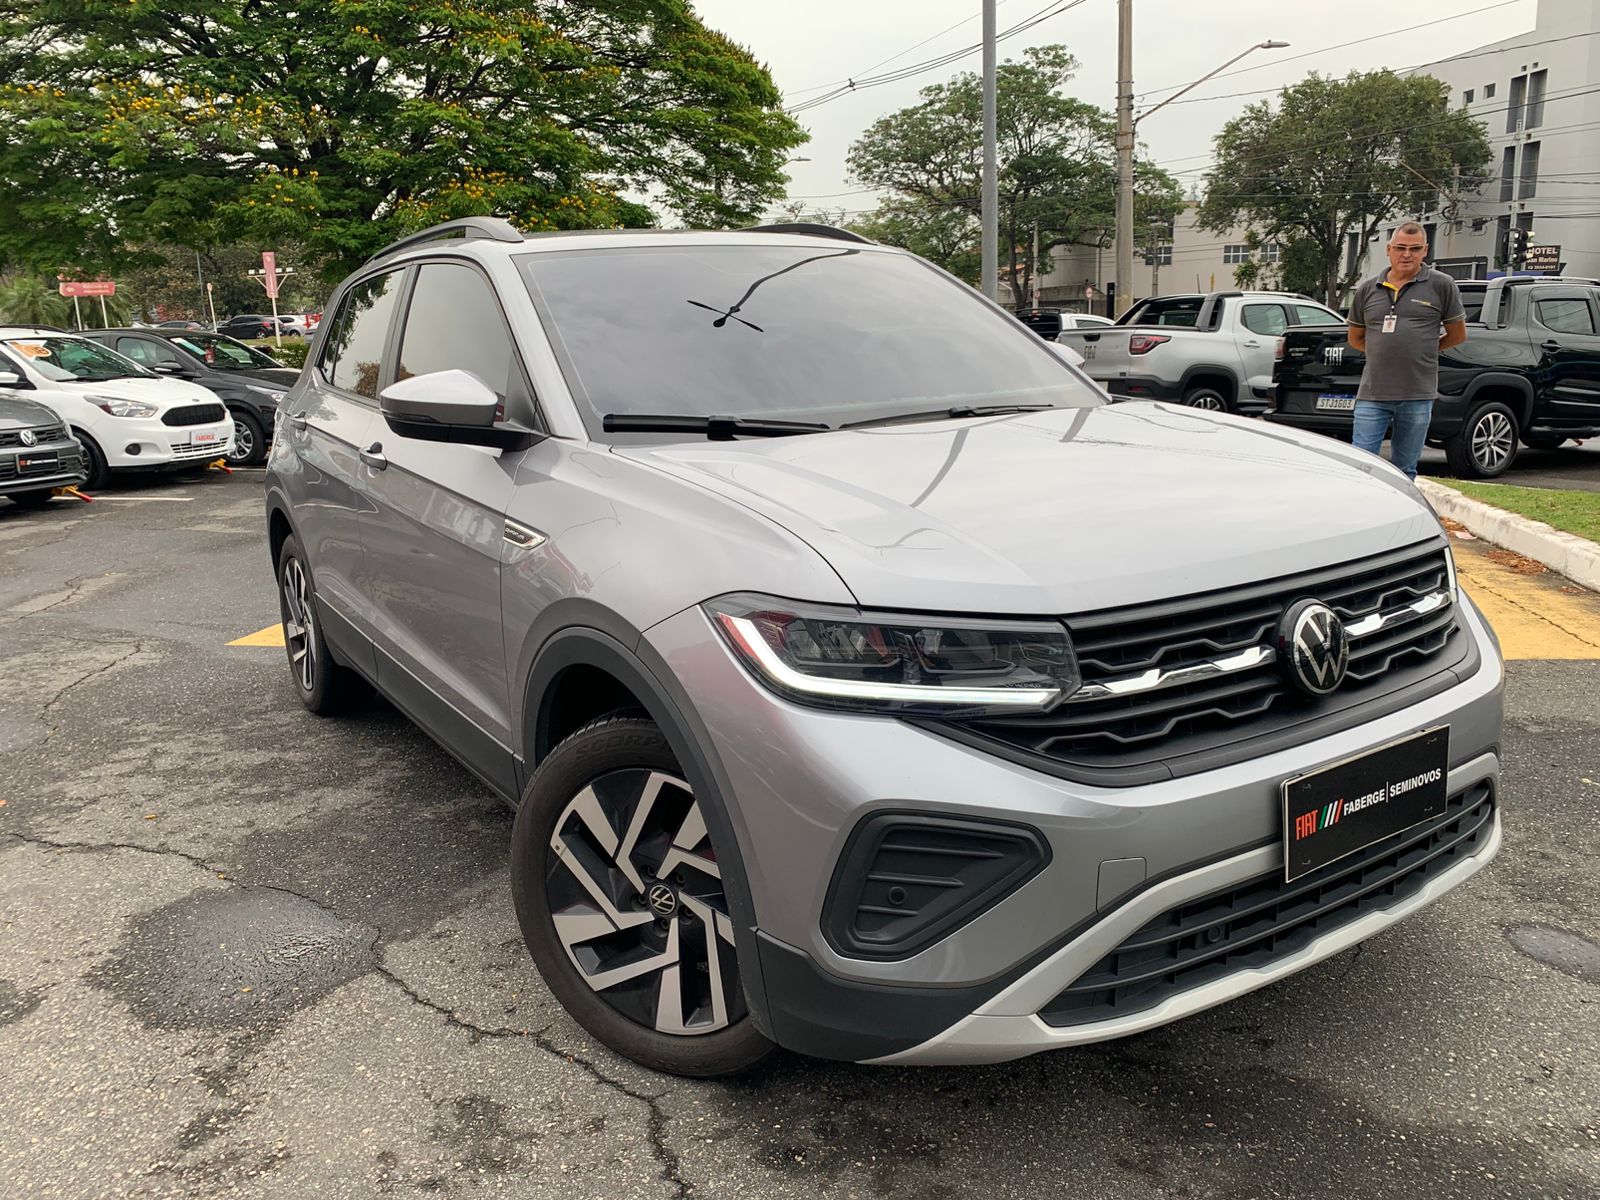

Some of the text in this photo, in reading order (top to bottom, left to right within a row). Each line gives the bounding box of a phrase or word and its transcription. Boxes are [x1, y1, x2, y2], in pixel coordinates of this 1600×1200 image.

[1324, 346, 1345, 365] FIAT
[1320, 398, 1352, 408] STJ1603
[1295, 767, 1442, 841] FIAT FABERGE SEMINOVOS
